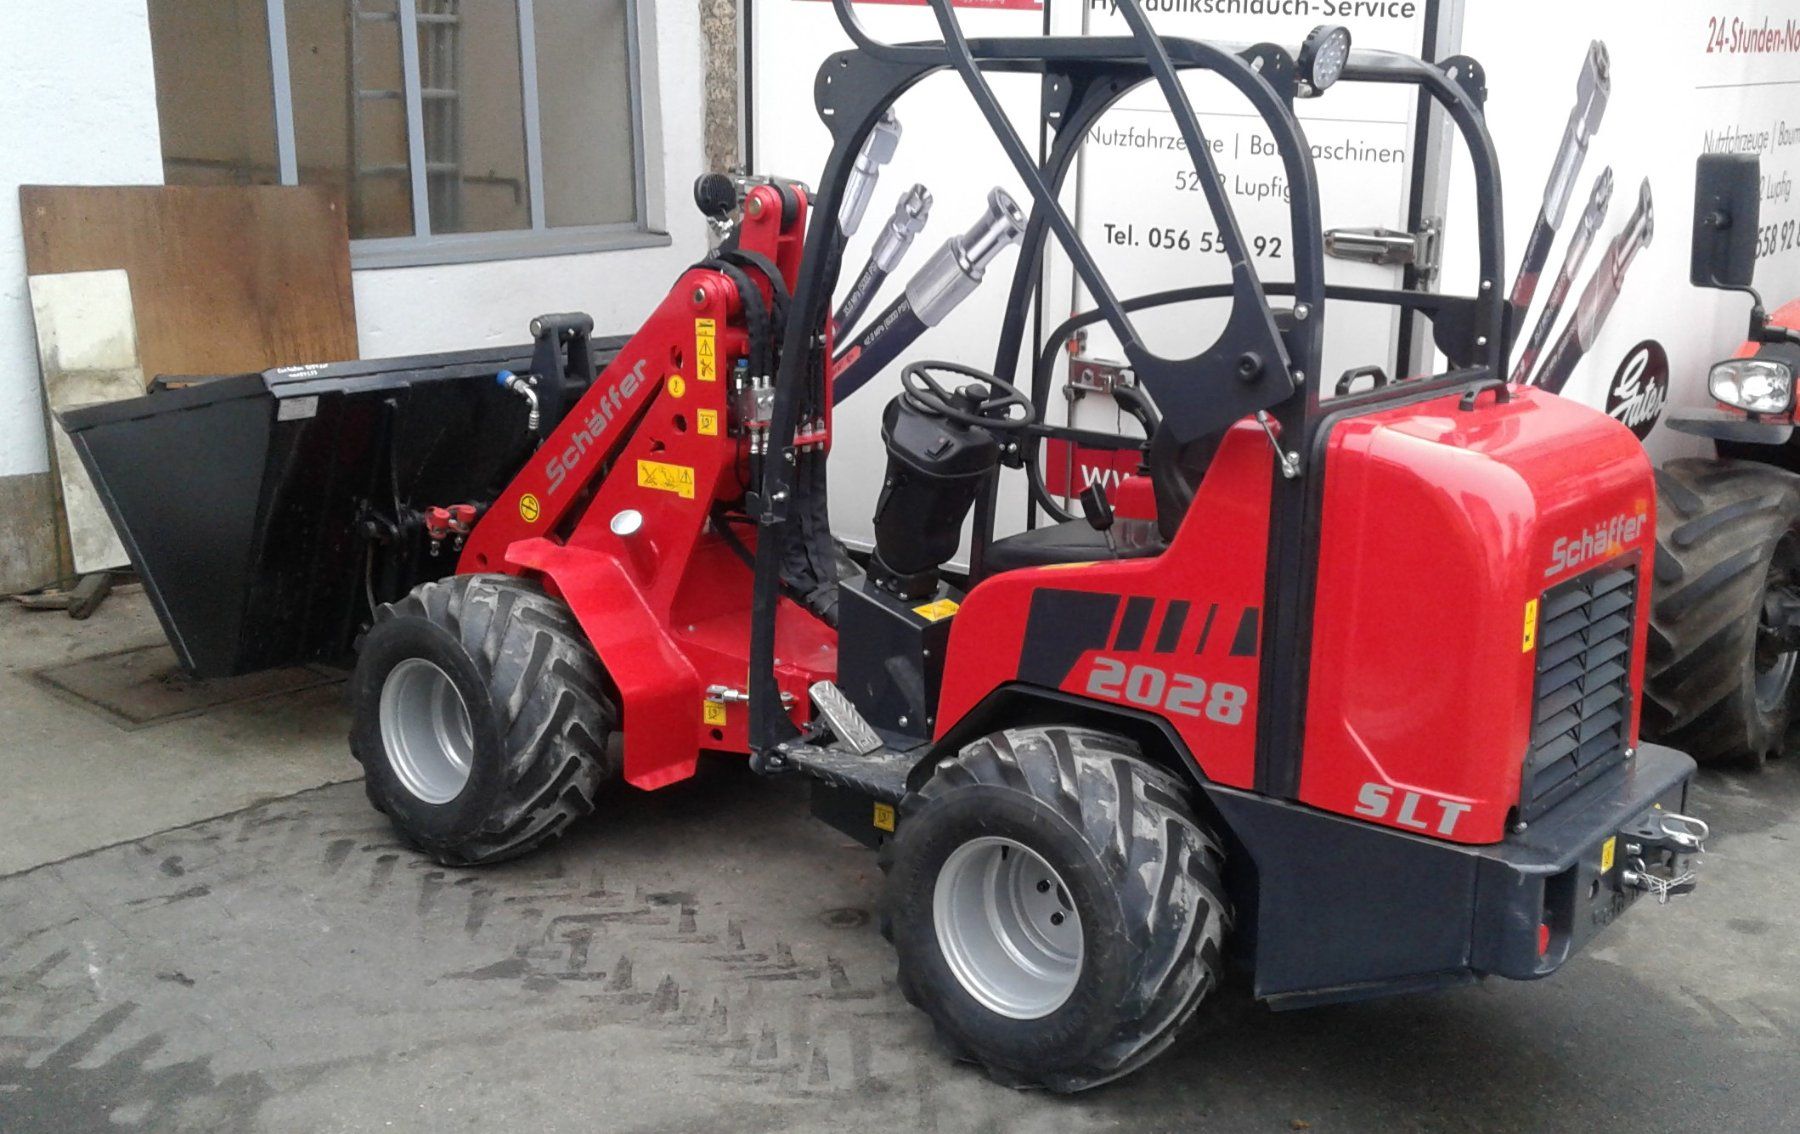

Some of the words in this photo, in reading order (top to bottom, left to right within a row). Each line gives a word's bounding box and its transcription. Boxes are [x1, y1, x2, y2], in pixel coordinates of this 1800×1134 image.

[1086, 126, 1224, 153] Nutzfahrzee
[1104, 223, 1139, 246] Tel.
[1149, 227, 1190, 250] 056
[1253, 235, 1282, 258] 92
[1780, 219, 1795, 251] 92
[1608, 348, 1666, 427] Gates
[544, 359, 647, 495] Schäffer
[1543, 513, 1647, 577] Schäffer
[1086, 656, 1248, 725] 2028
[1354, 782, 1472, 836] SLT
